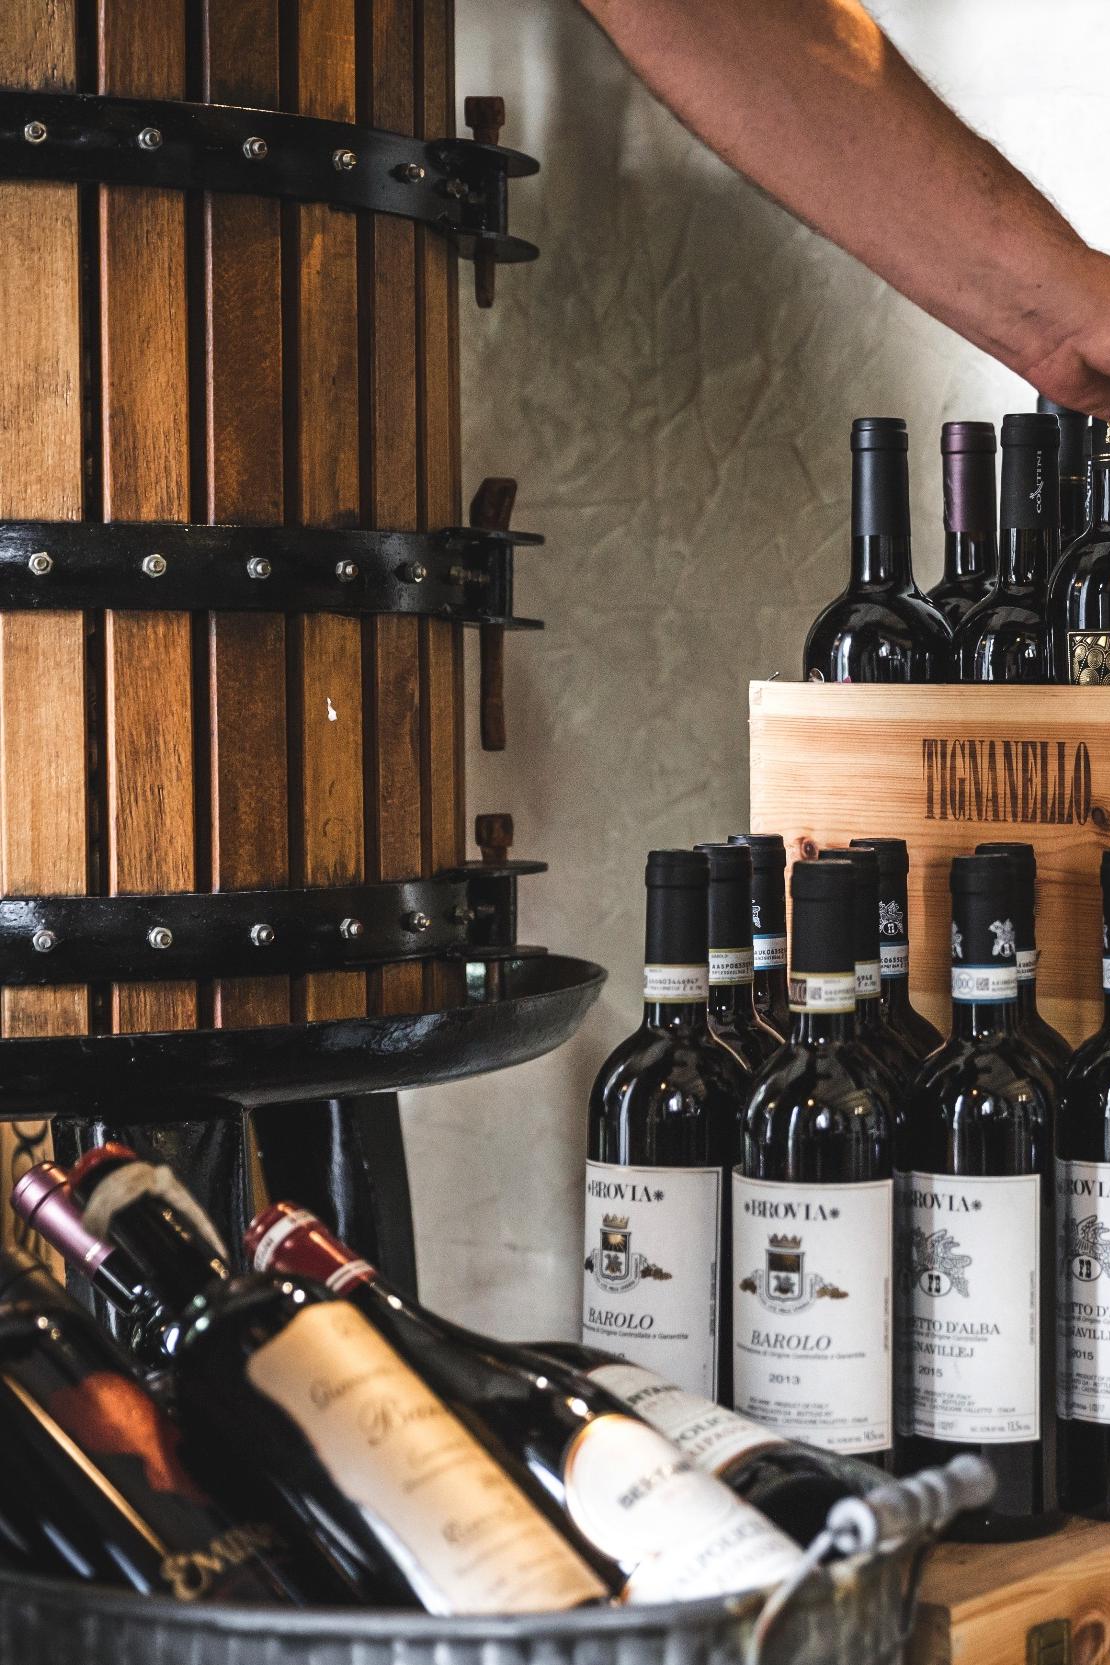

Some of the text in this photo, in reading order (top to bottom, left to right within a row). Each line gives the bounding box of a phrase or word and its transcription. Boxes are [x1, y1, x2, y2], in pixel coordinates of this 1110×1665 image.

[922, 738, 1092, 825] TIGNANELLO
[591, 1180, 652, 1202] BROVIA
[750, 1199, 828, 1221] BROVIA
[589, 1307, 654, 1330] BAROLO
[946, 1321, 1001, 1335] D'ALBA
[751, 1329, 832, 1351] BAROLO
[769, 1373, 801, 1385] 2013
